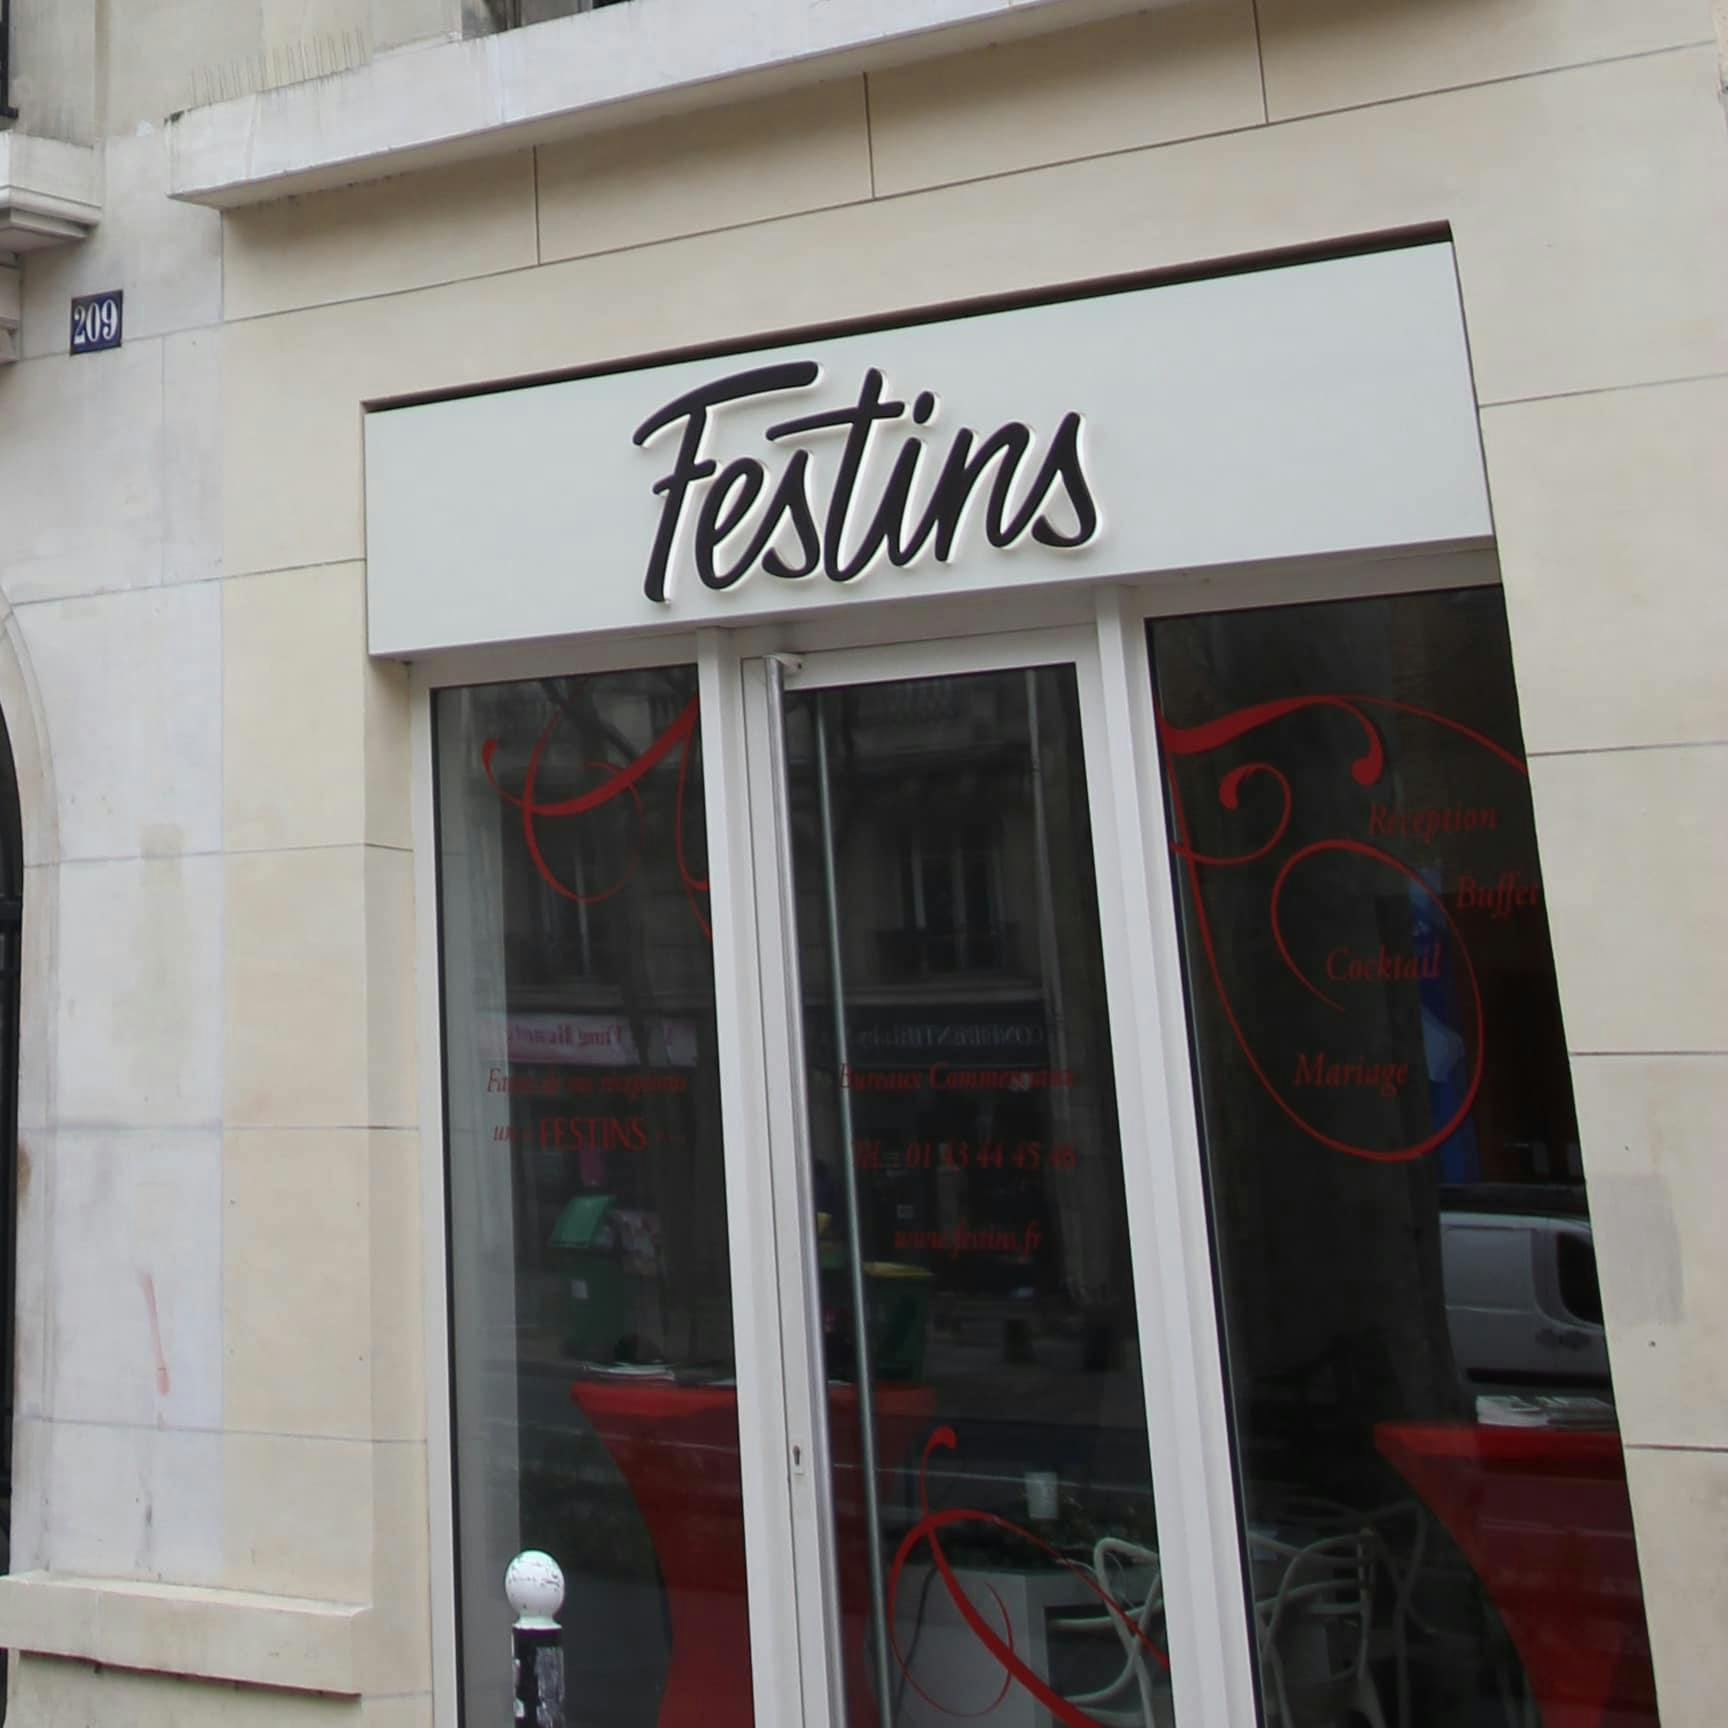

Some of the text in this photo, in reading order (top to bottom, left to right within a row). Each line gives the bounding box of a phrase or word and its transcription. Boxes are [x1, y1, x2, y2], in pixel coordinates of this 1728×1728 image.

[74, 299, 119, 345] 209
[633, 361, 1098, 603] Festins
[1326, 942, 1442, 982] Cocktail
[1294, 1050, 1409, 1097] Mariage
[539, 1114, 647, 1151] FESTINS
